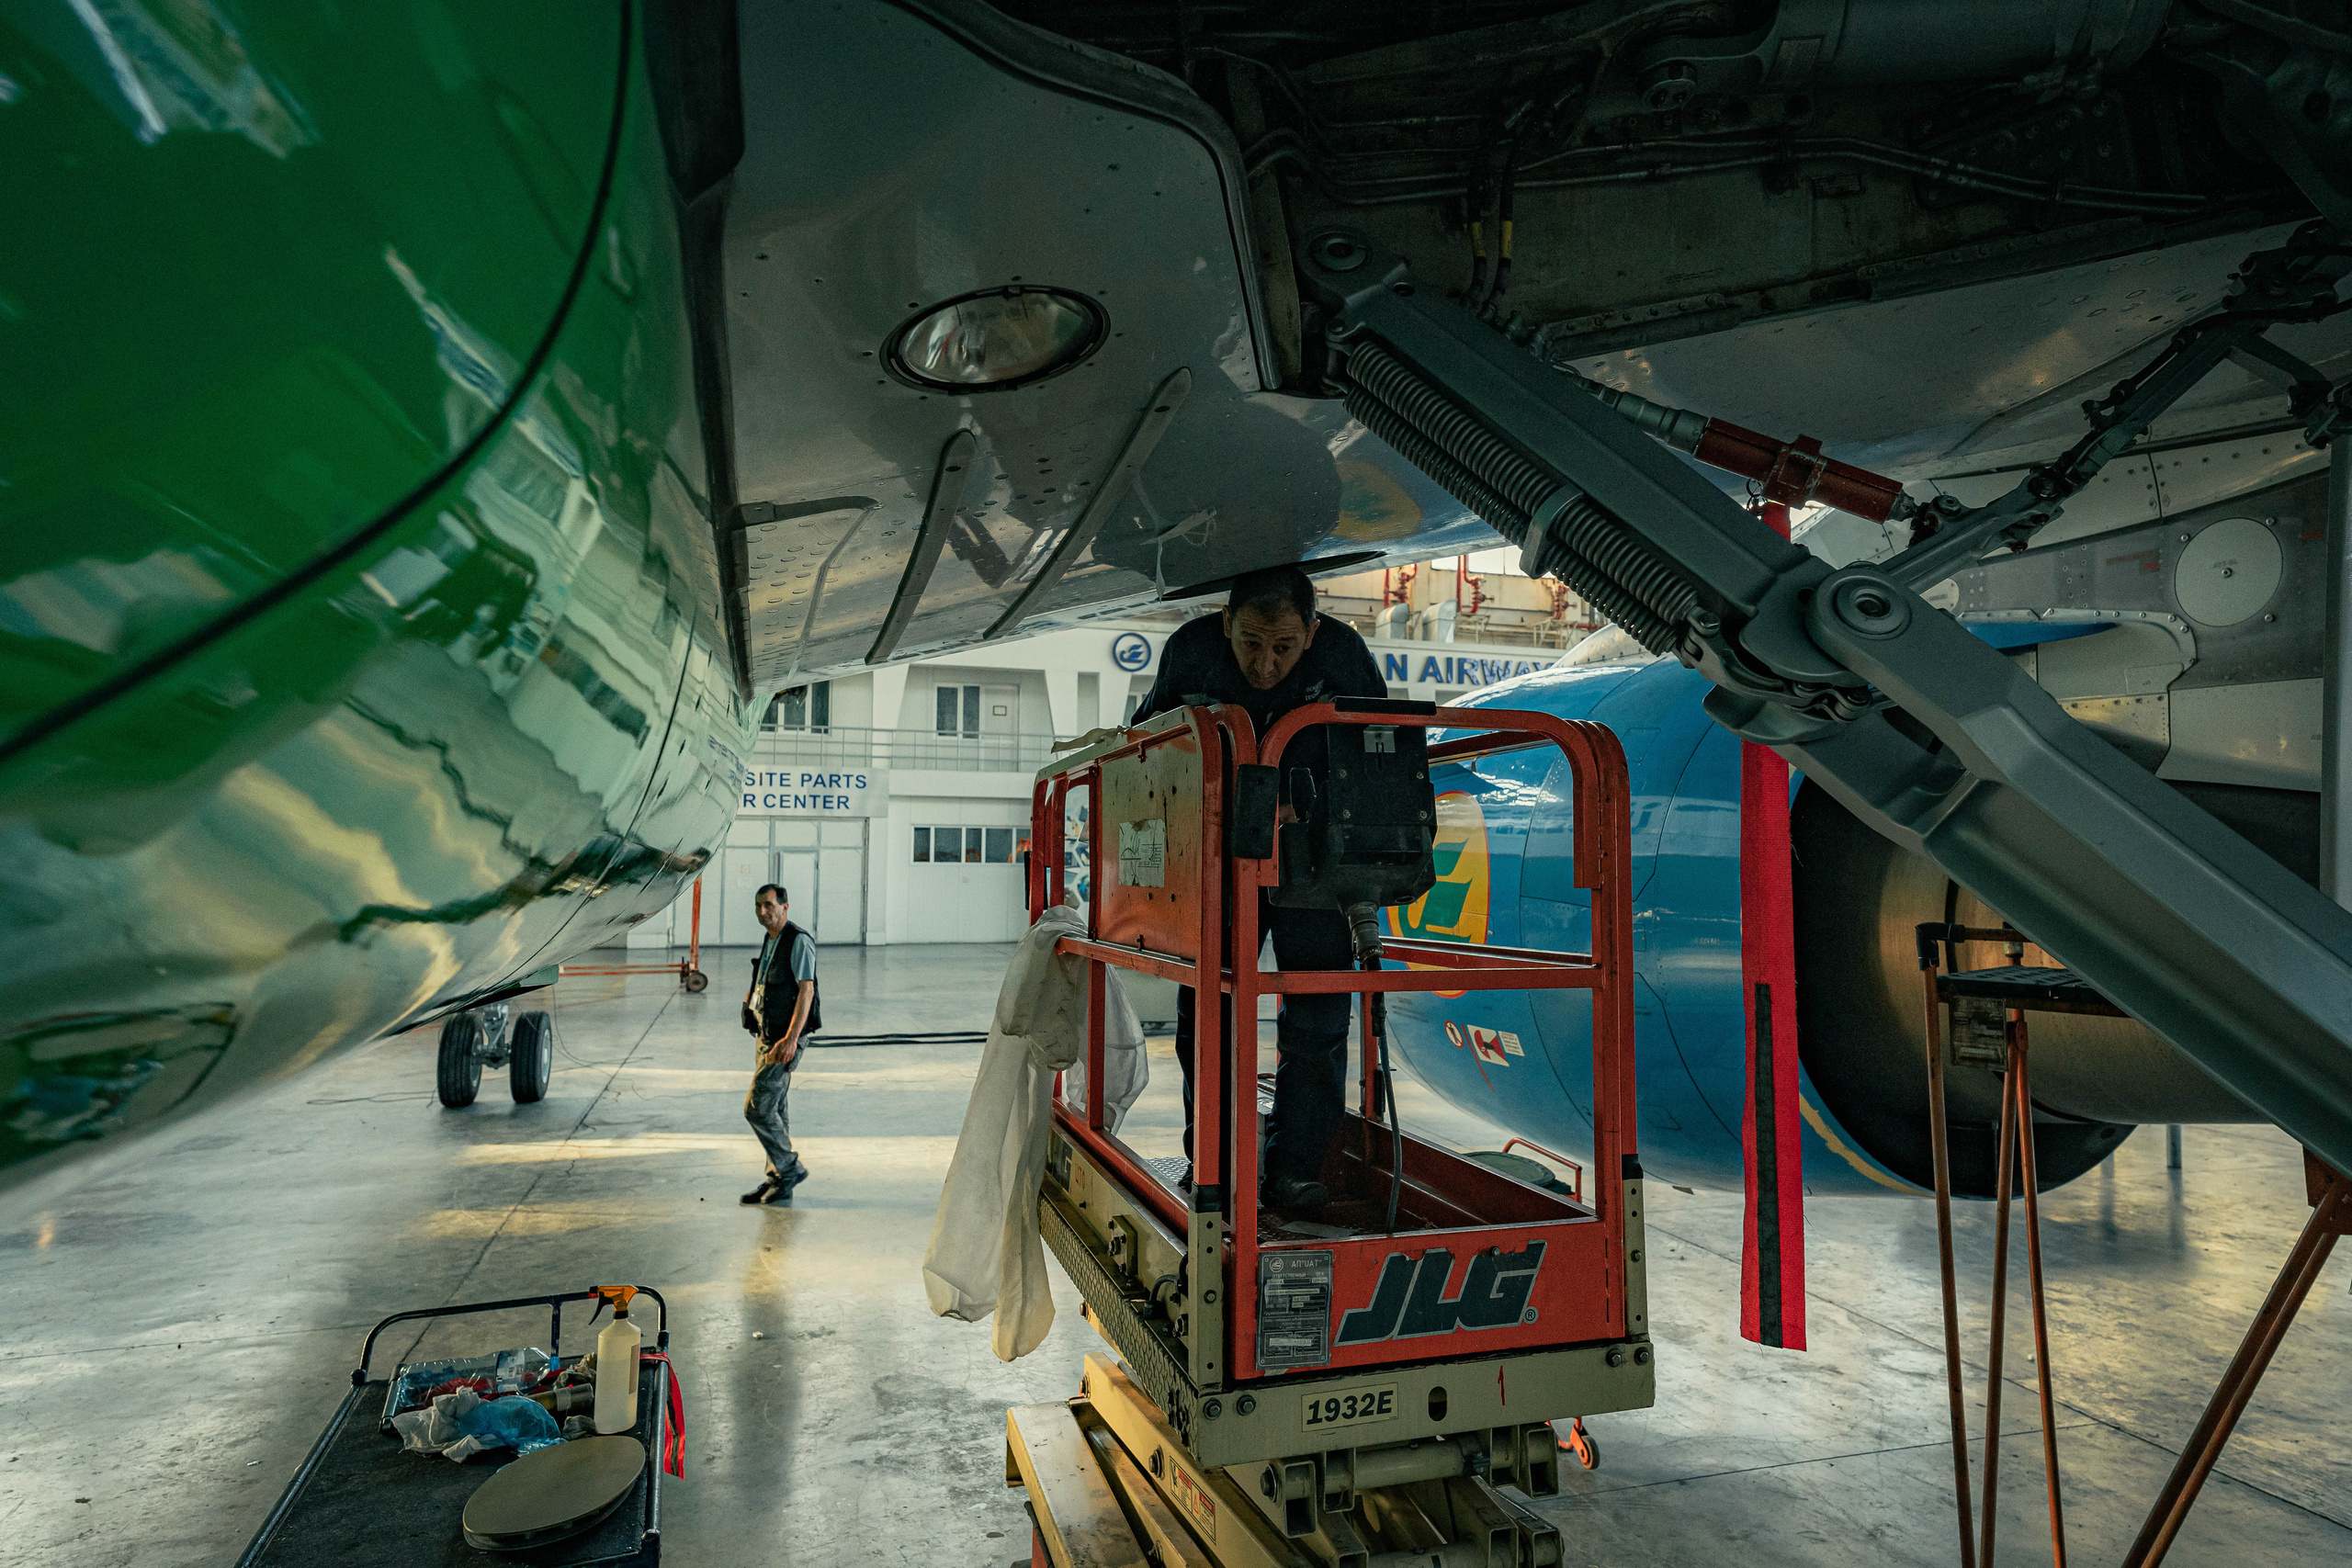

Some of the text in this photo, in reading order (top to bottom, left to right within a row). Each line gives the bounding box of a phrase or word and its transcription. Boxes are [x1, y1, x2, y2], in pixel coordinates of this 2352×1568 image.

[1371, 652, 1408, 682] N
[744, 772, 867, 789] SITE PARTS
[742, 794, 850, 809] R CENTER
[1333, 1240, 1547, 1347] JLG
[1306, 1390, 1394, 1425] 1932E
